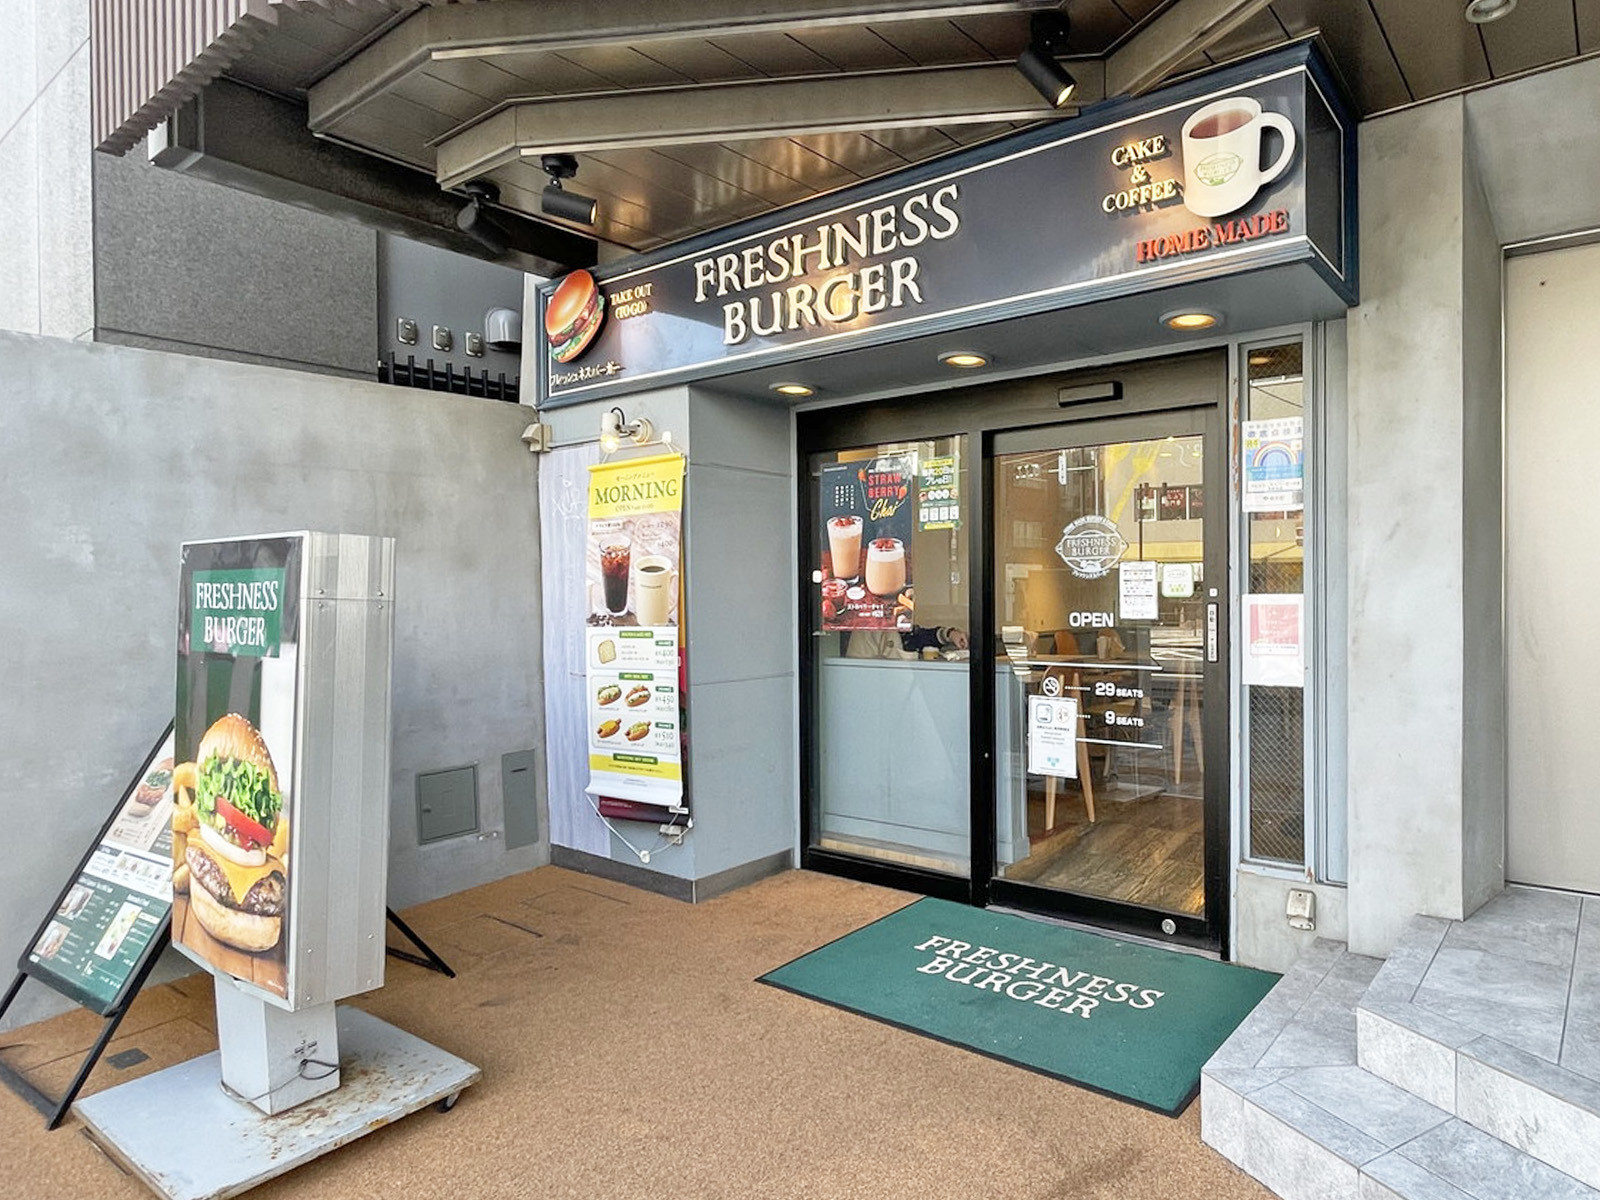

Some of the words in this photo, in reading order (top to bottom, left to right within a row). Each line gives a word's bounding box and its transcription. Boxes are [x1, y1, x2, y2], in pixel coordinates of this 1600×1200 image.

[1111, 134, 1166, 166] CAKE
[1129, 164, 1147, 184] &
[1101, 178, 1177, 213] COFFEE
[694, 184, 960, 303] FRESHNESS
[1135, 225, 1210, 263] HOME
[1212, 207, 1289, 245] MADE
[609, 288, 633, 306] TAKE
[634, 282, 653, 299] OUT
[722, 256, 923, 346] BURGER
[594, 478, 678, 506] MORNING
[868, 472, 901, 487] STRAW
[868, 487, 901, 498] BERRY
[869, 498, 900, 522] Chai
[1071, 547, 1111, 557] BURGER
[195, 580, 279, 611] FRESHNESS
[204, 615, 266, 647] BURGER
[1069, 612, 1115, 628] OPEN
[1095, 682, 1116, 697] 29
[1116, 689, 1144, 699] SEATS
[1105, 710, 1116, 726] 9
[1116, 717, 1145, 728] SEATS
[914, 935, 1165, 1009] FRESHNESS
[916, 956, 1100, 1019] BURGER
